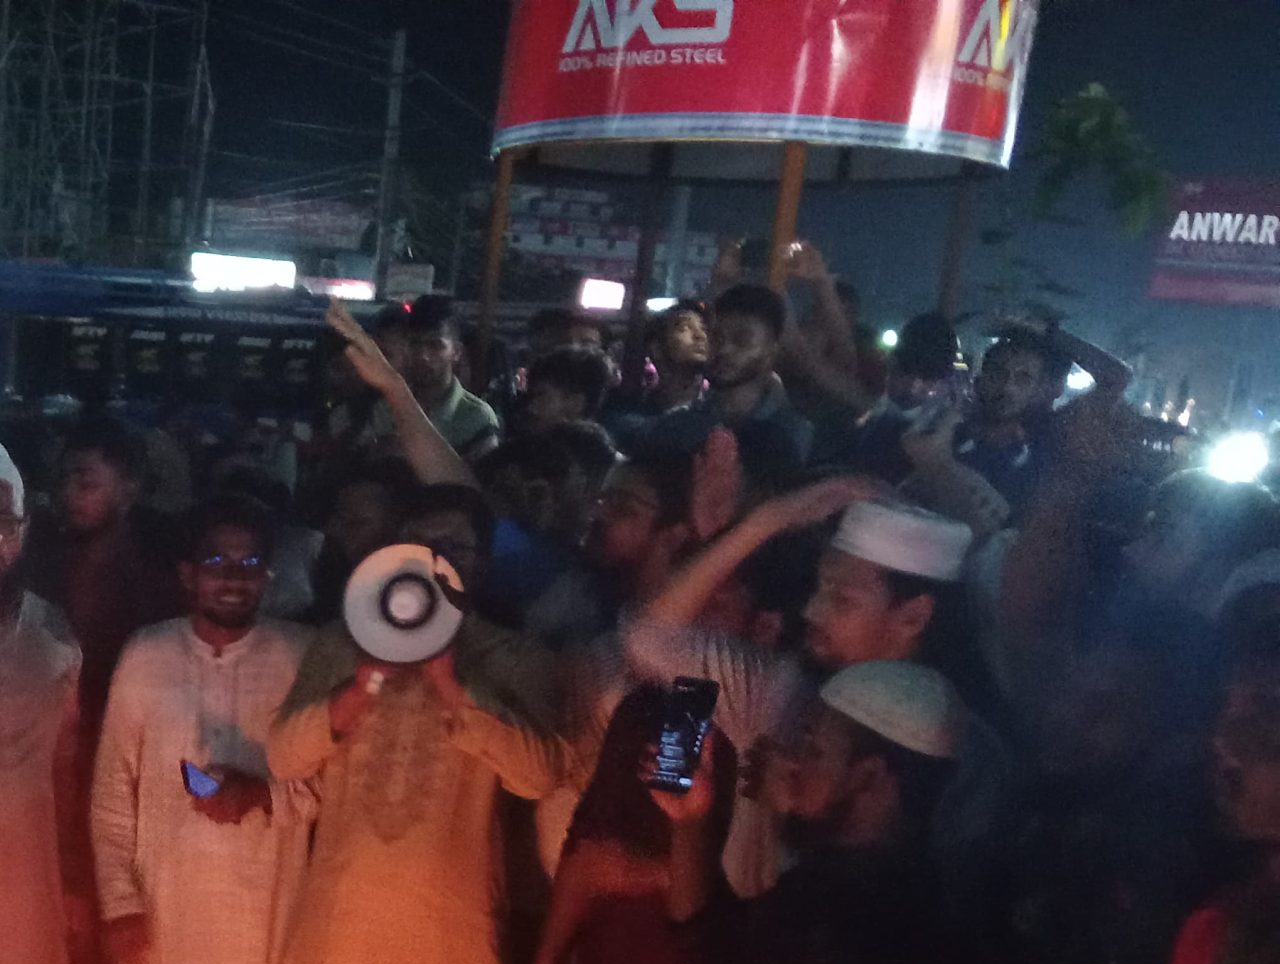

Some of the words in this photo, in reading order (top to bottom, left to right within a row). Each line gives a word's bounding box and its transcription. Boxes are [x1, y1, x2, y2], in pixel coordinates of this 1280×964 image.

[562, 0, 734, 53] AKS
[559, 54, 593, 72] 100%
[596, 49, 666, 68] REFINED
[670, 47, 726, 65] STEEL
[1169, 210, 1280, 246] ANWAR
